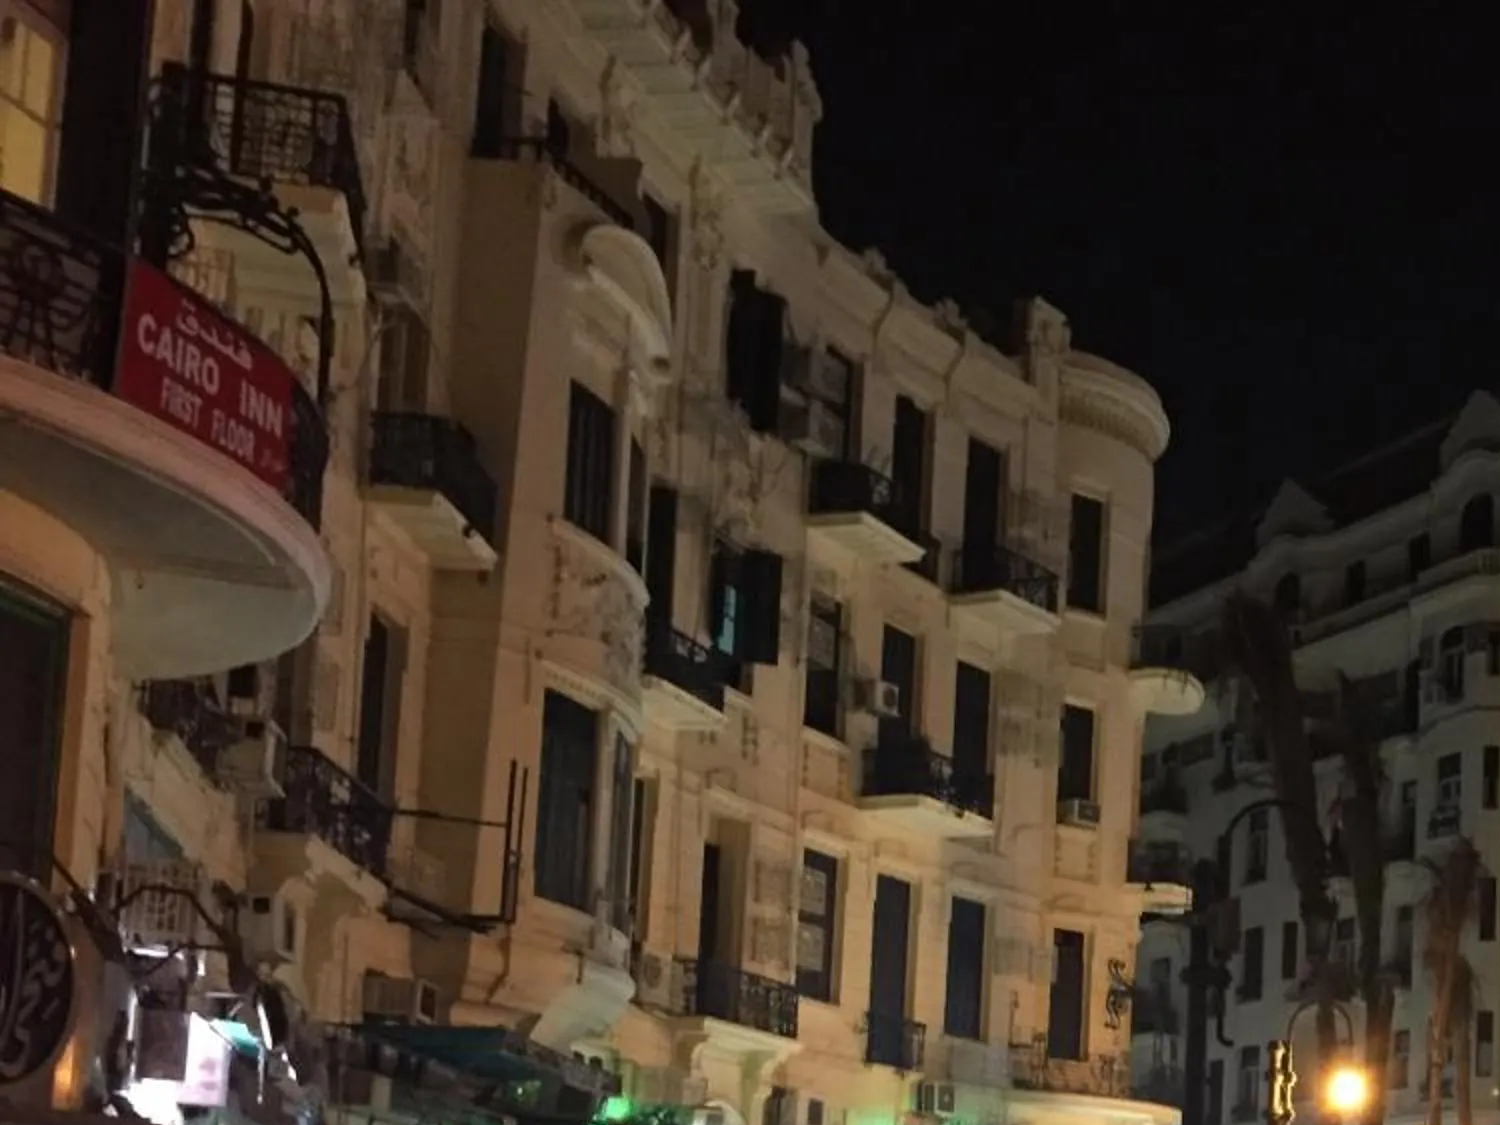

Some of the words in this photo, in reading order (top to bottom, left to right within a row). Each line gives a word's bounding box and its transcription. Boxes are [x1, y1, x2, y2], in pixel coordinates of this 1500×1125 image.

[137, 312, 220, 397] CAIRO
[239, 376, 283, 440] INN
[176, 299, 253, 370] فندق
[161, 376, 203, 430] FIRST
[212, 407, 256, 464] FLOOR
